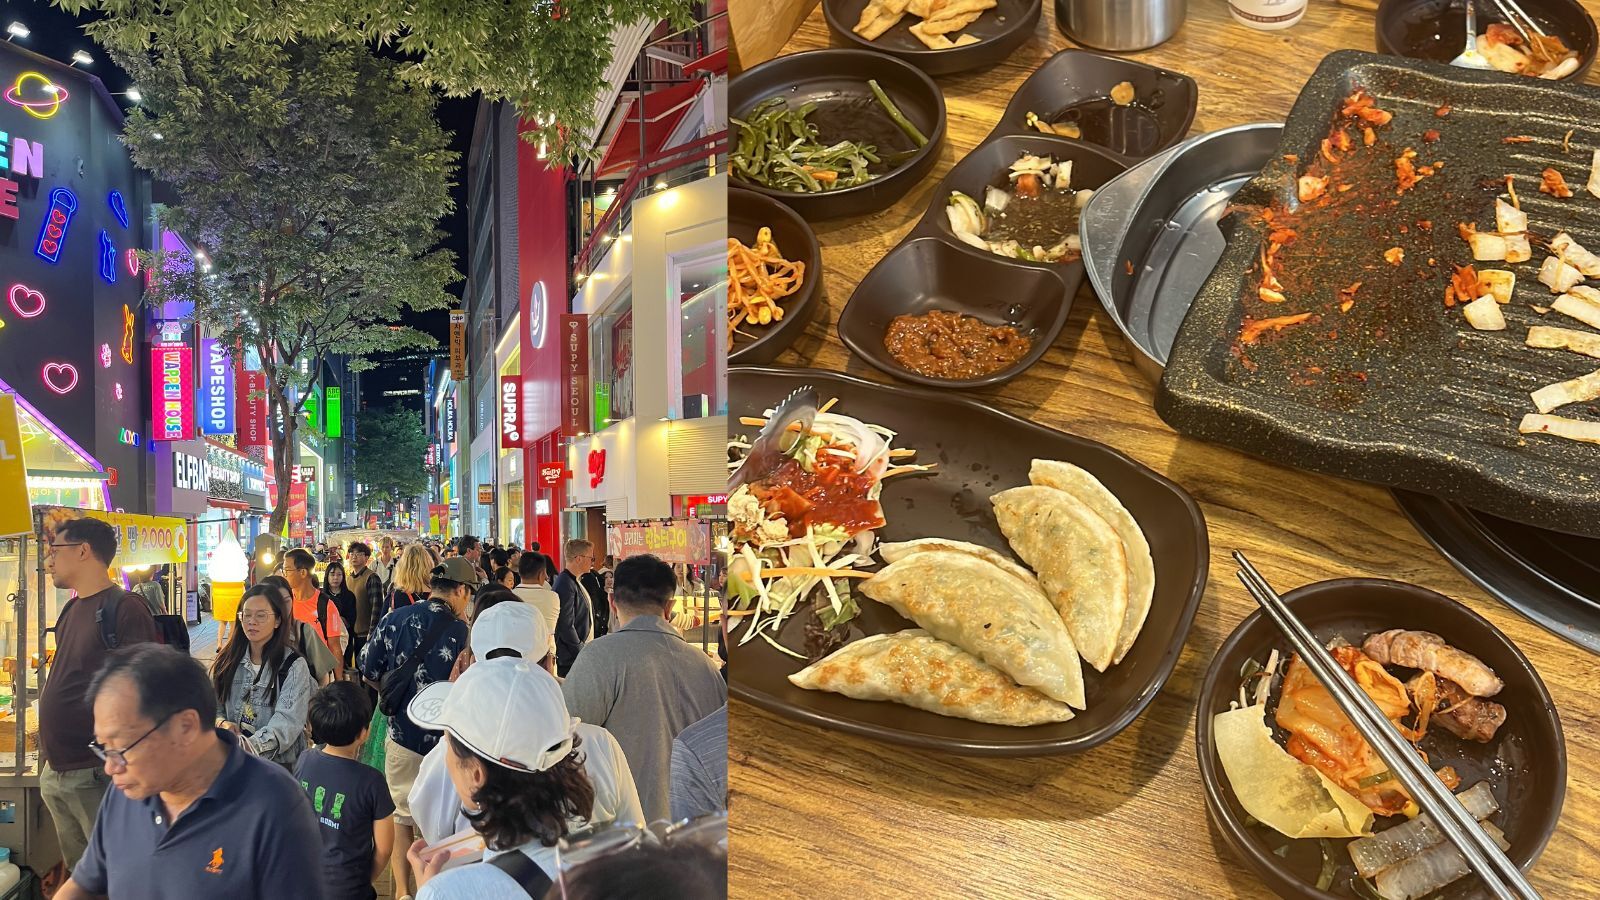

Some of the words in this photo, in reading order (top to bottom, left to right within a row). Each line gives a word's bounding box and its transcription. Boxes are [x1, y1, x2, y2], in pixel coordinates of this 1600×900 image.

[570, 333, 578, 372] SUPY
[163, 351, 181, 400] WAPPEN
[210, 342, 226, 430] VAPESHOP
[164, 401, 182, 439] HOUSE
[503, 382, 517, 434] SUPRA
[571, 377, 579, 426] SEOUL
[176, 452, 210, 492] ELFBAR
[707, 495, 727, 504] SUPY
[141, 527, 173, 551] 2,000
